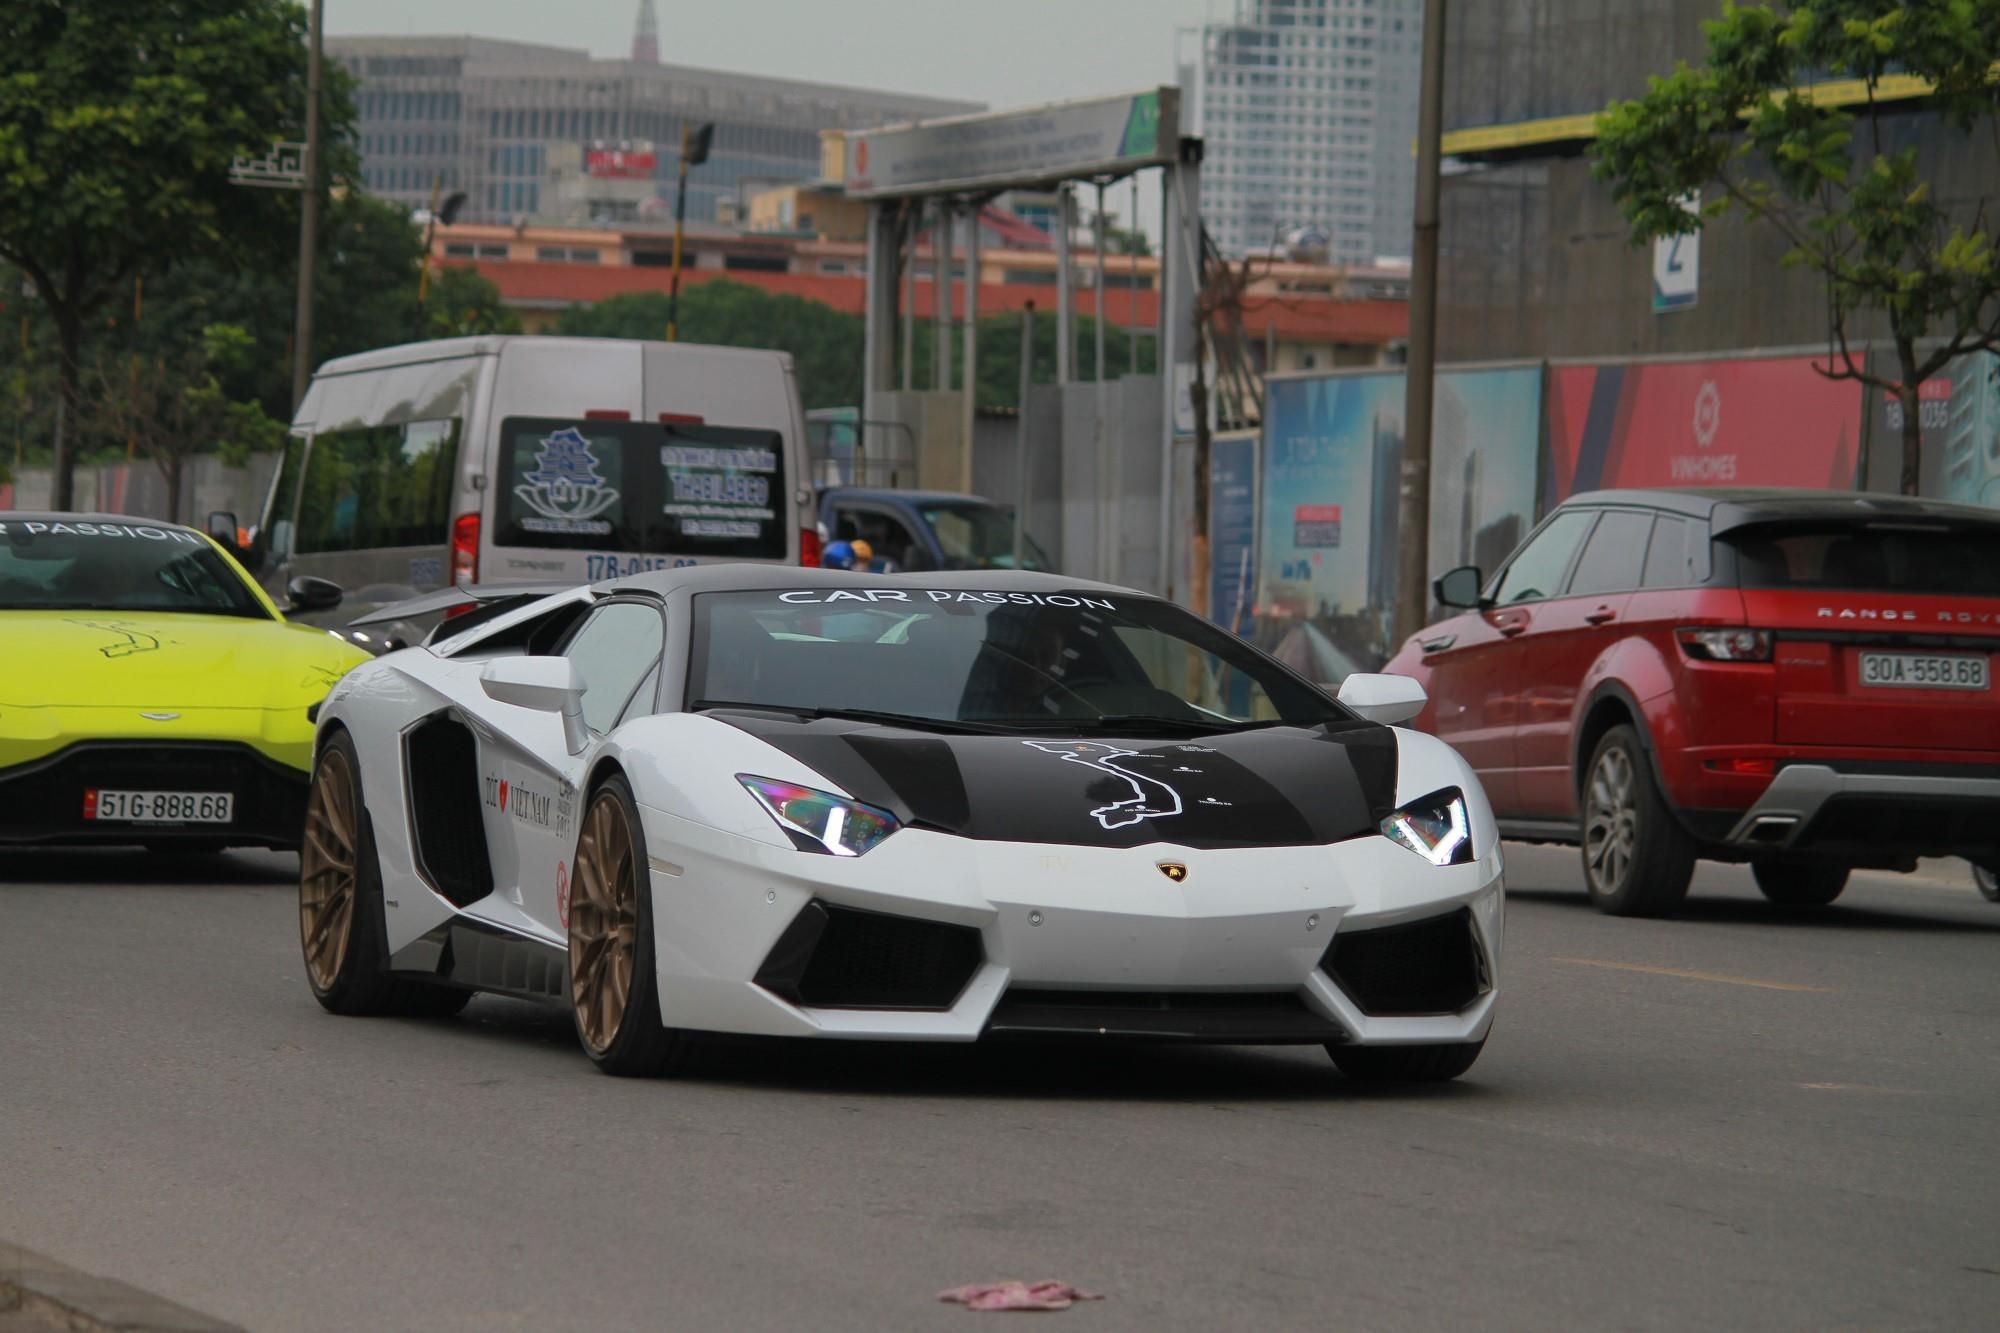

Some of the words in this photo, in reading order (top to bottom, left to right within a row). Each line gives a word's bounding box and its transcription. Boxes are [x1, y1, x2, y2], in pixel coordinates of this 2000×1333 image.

[1670, 455, 1737, 480] VINHOMES
[24, 521, 200, 545] PASSION
[778, 590, 912, 604] CAR
[925, 590, 1116, 611] PASSION
[1817, 607, 1918, 621] RANGE
[1865, 657, 1983, 685] 30A-558.68
[101, 794, 228, 820] 51G-888.68
